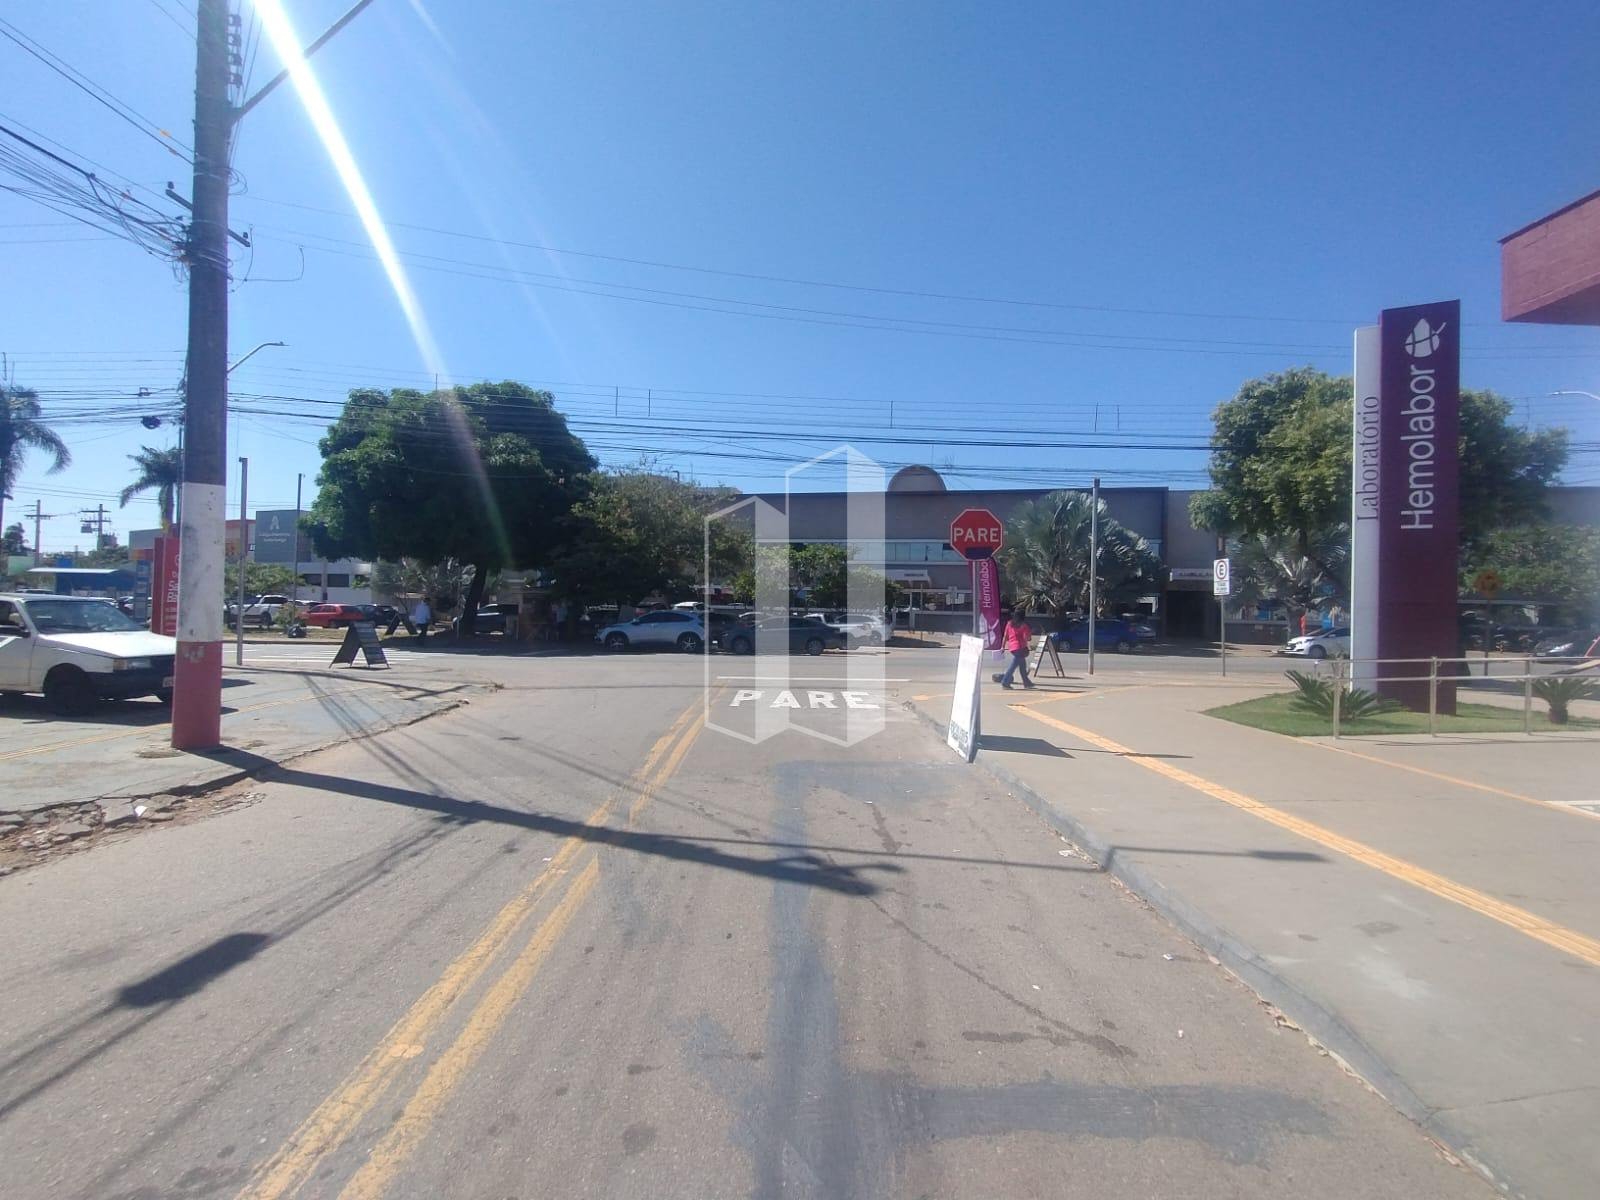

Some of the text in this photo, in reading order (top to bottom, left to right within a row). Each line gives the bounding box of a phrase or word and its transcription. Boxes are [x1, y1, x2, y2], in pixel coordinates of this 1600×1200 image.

[1355, 396, 1380, 521] Laboratório
[1400, 364, 1435, 529] Hemolabor
[952, 527, 1000, 543] PARE
[979, 561, 992, 608] Hemolabo
[729, 689, 881, 709] PARE
